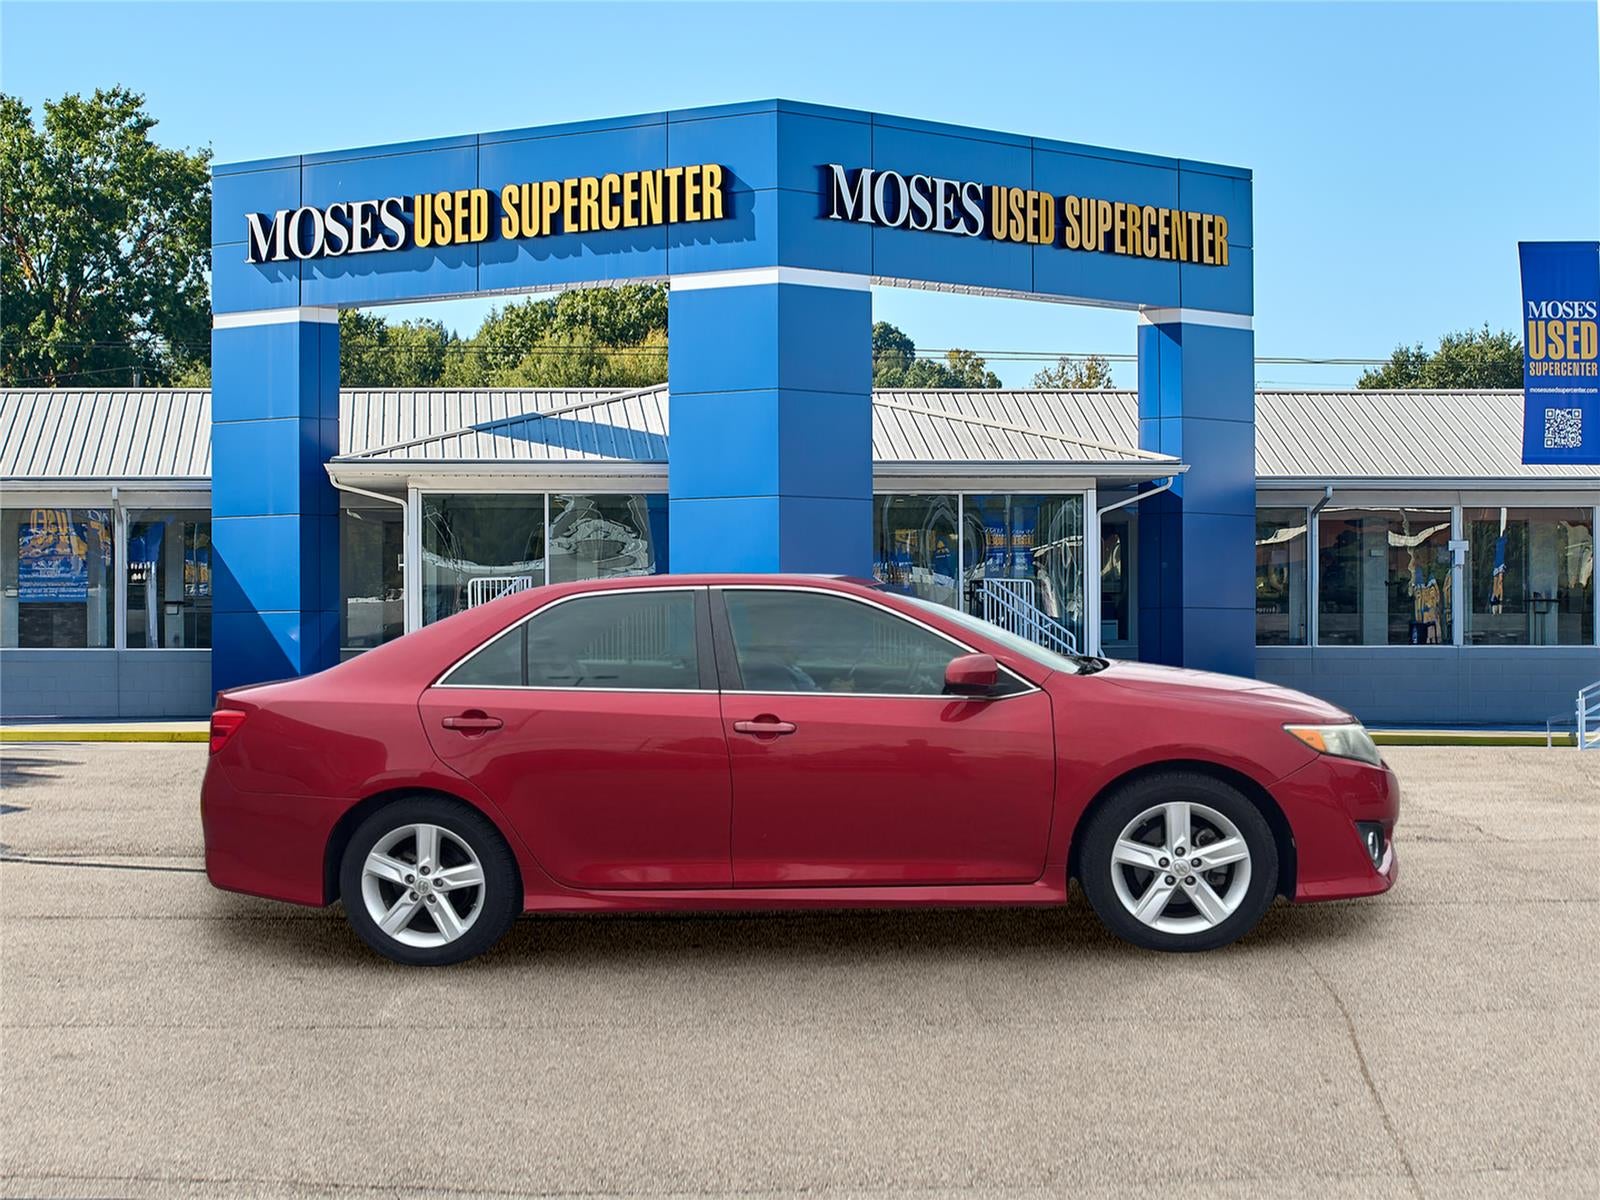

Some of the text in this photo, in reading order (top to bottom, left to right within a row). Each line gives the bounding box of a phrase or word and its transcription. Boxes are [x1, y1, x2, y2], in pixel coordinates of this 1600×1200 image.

[244, 163, 724, 264] MOSES USED SUPERCENTER
[829, 163, 1230, 267] MOSES USED SUPERCENTER
[1527, 300, 1598, 319] MOSES
[1528, 320, 1598, 360] USED
[1529, 362, 1598, 376] SUPERCENTER
